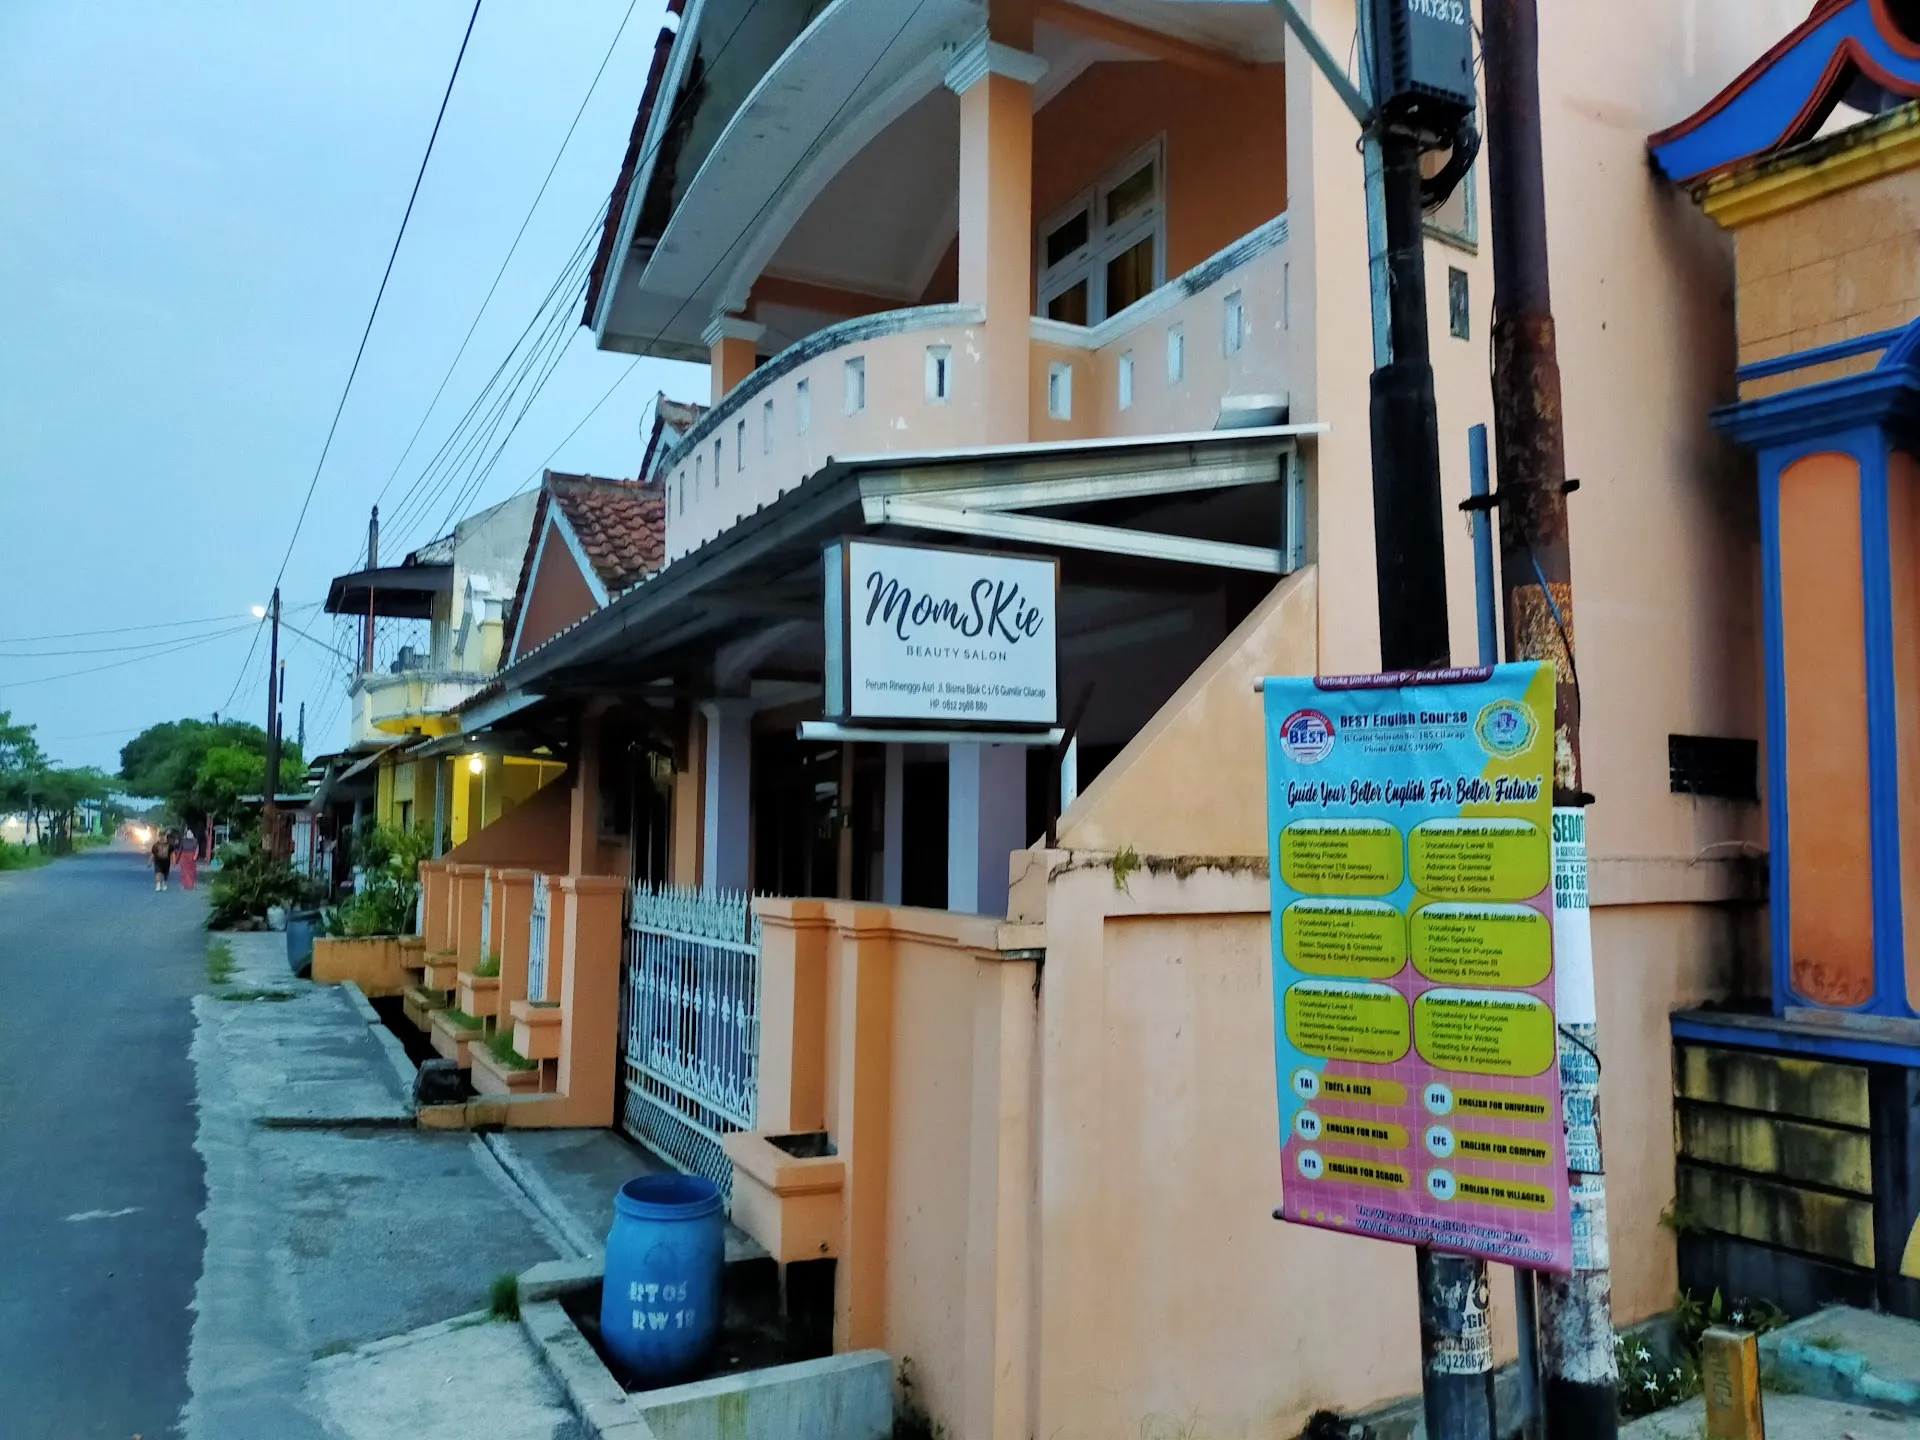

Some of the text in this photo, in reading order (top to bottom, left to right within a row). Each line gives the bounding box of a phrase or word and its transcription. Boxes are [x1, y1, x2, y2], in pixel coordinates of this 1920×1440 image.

[866, 571, 1043, 643] MomSKie
[907, 645, 1006, 660] BEAUTY SALON
[1320, 676, 1347, 686] Terbuka
[1350, 674, 1371, 685] Untuk
[1374, 674, 1398, 684] Umum
[1463, 667, 1487, 677] Privat
[866, 679, 888, 691] Perum
[946, 682, 966, 694] Bisma
[966, 684, 980, 696] Blok
[1023, 686, 1046, 700] Cilacap
[1340, 714, 1369, 728] BEST
[1373, 712, 1416, 728] English
[1420, 712, 1468, 724] Course
[1290, 730, 1325, 744] BEST
[1435, 731, 1466, 741] Cilacap
[1320, 780, 1346, 808] Your
[1349, 780, 1382, 806] Better
[1385, 778, 1426, 808] English
[1430, 778, 1452, 804] For
[1456, 777, 1491, 804] Better
[1325, 1082, 1344, 1092] TOEFL
[1459, 1098, 1545, 1114] ENGLISH FOR UNIVERSITY
[1327, 1123, 1388, 1140] ENGLISH FOR KIDS
[1460, 1140, 1546, 1159] ENGLISH FOR COMPANY
[1328, 1162, 1404, 1184] ENGLISH FOR SCHOOL
[1460, 1183, 1546, 1204] ENGLISH FOR VILLAGERS
[630, 1281, 660, 1304] RT
[632, 1308, 669, 1331] RW
